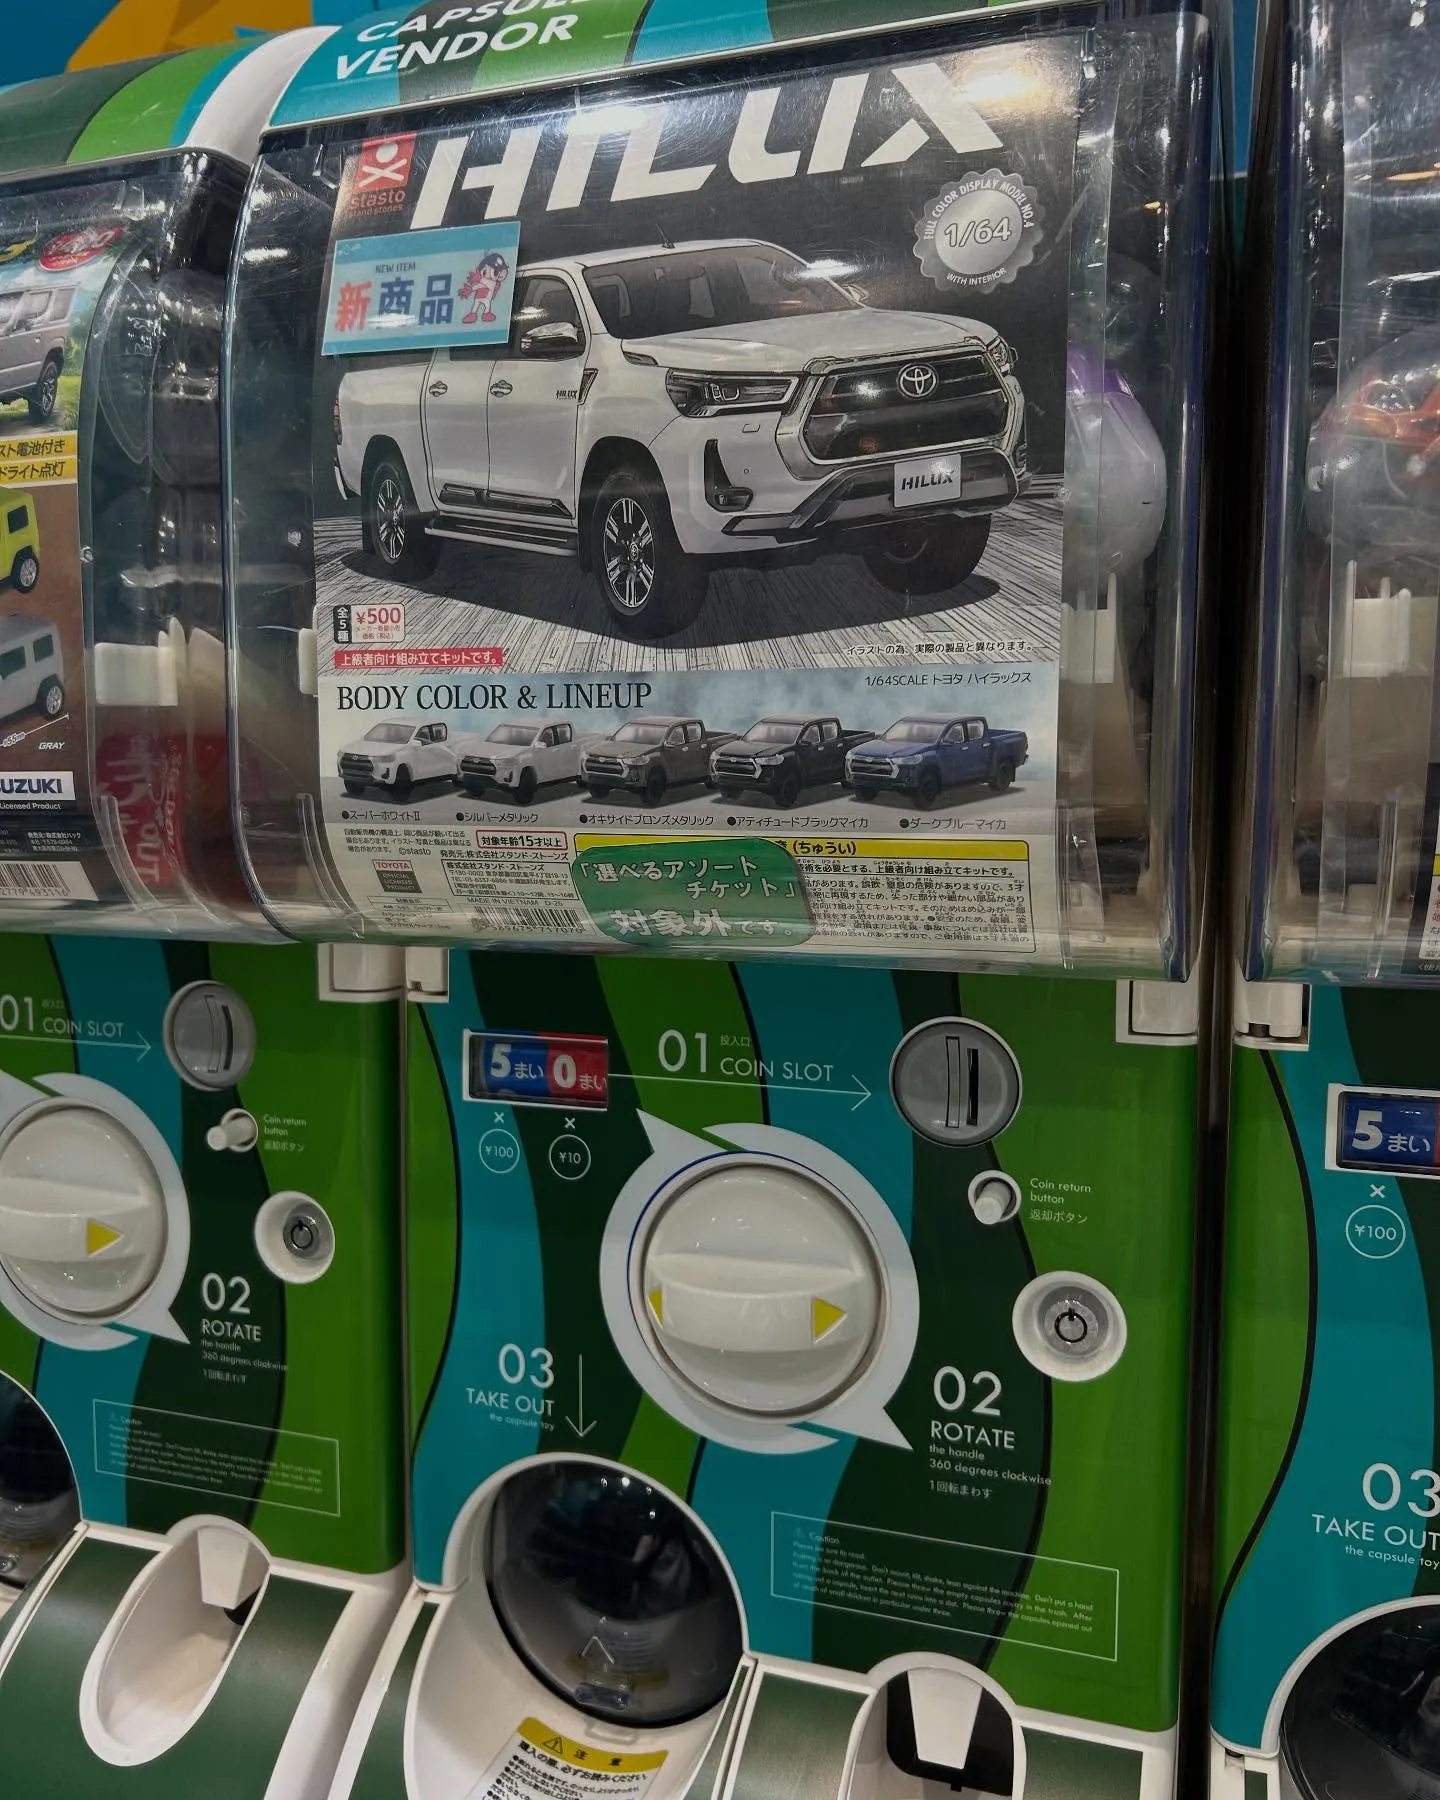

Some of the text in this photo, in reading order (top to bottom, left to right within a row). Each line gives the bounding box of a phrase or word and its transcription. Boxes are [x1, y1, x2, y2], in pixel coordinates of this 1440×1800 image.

[357, 0, 592, 43] CAPSU
[337, 14, 579, 80] VENDOR
[410, 61, 1003, 230] HILUX
[350, 189, 406, 210] stasto
[923, 219, 938, 240] FULL
[932, 190, 959, 218] COLOR
[959, 179, 1000, 195] DISPLAY
[999, 181, 1027, 206] MODEL
[944, 217, 1011, 247] 1/64
[375, 261, 416, 273] NEW ITEM
[946, 267, 1007, 286] WITH INTERIOR
[335, 273, 454, 333] 新商品
[902, 470, 954, 490] HILUX
[356, 607, 401, 625] ¥500
[341, 651, 498, 667] 上級者向け組み立てキットです。
[864, 671, 1032, 687] 1/64SCALE トヨタ ハイラックス
[337, 683, 652, 711] BODY COLOR & LINEUP
[38, 742, 65, 750] GRAY
[0, 778, 62, 794] UZUKI
[32, 802, 62, 810] Product
[482, 835, 563, 848] 対象年齢15才以上
[580, 855, 758, 882] 「選べるアソート
[686, 877, 795, 899] チケット」
[610, 909, 792, 936] 対象外です。
[0, 994, 34, 1032] 01
[42, 1017, 124, 1038] COIN SLOT
[658, 1029, 707, 1073] 01
[720, 1034, 750, 1047] 投入口
[720, 1057, 834, 1082] COIN SLOT
[1351, 1109, 1431, 1153] 5まい
[484, 1145, 514, 1158] ¥100
[559, 1151, 582, 1164] ¥10
[1030, 1177, 1091, 1193] Coin return
[1030, 1191, 1065, 1204] button
[1030, 1209, 1088, 1224] 返却ボタン
[1355, 1223, 1397, 1241] ¥100
[202, 1272, 251, 1314] 02
[201, 1318, 261, 1342] ROTATE
[202, 1340, 214, 1348] the
[498, 1343, 555, 1389] 03
[465, 1387, 555, 1417] TAKE OUT
[933, 1365, 1002, 1416] 02
[931, 1420, 1015, 1449] ROTATE
[929, 1444, 985, 1460] the handle
[929, 1458, 1052, 1486] 360 degrees clockwise
[1362, 1462, 1440, 1518] 03
[809, 1531, 840, 1544] Caution
[1312, 1513, 1440, 1551] TAKE OUT
[1345, 1544, 1440, 1570] the capsule toy
